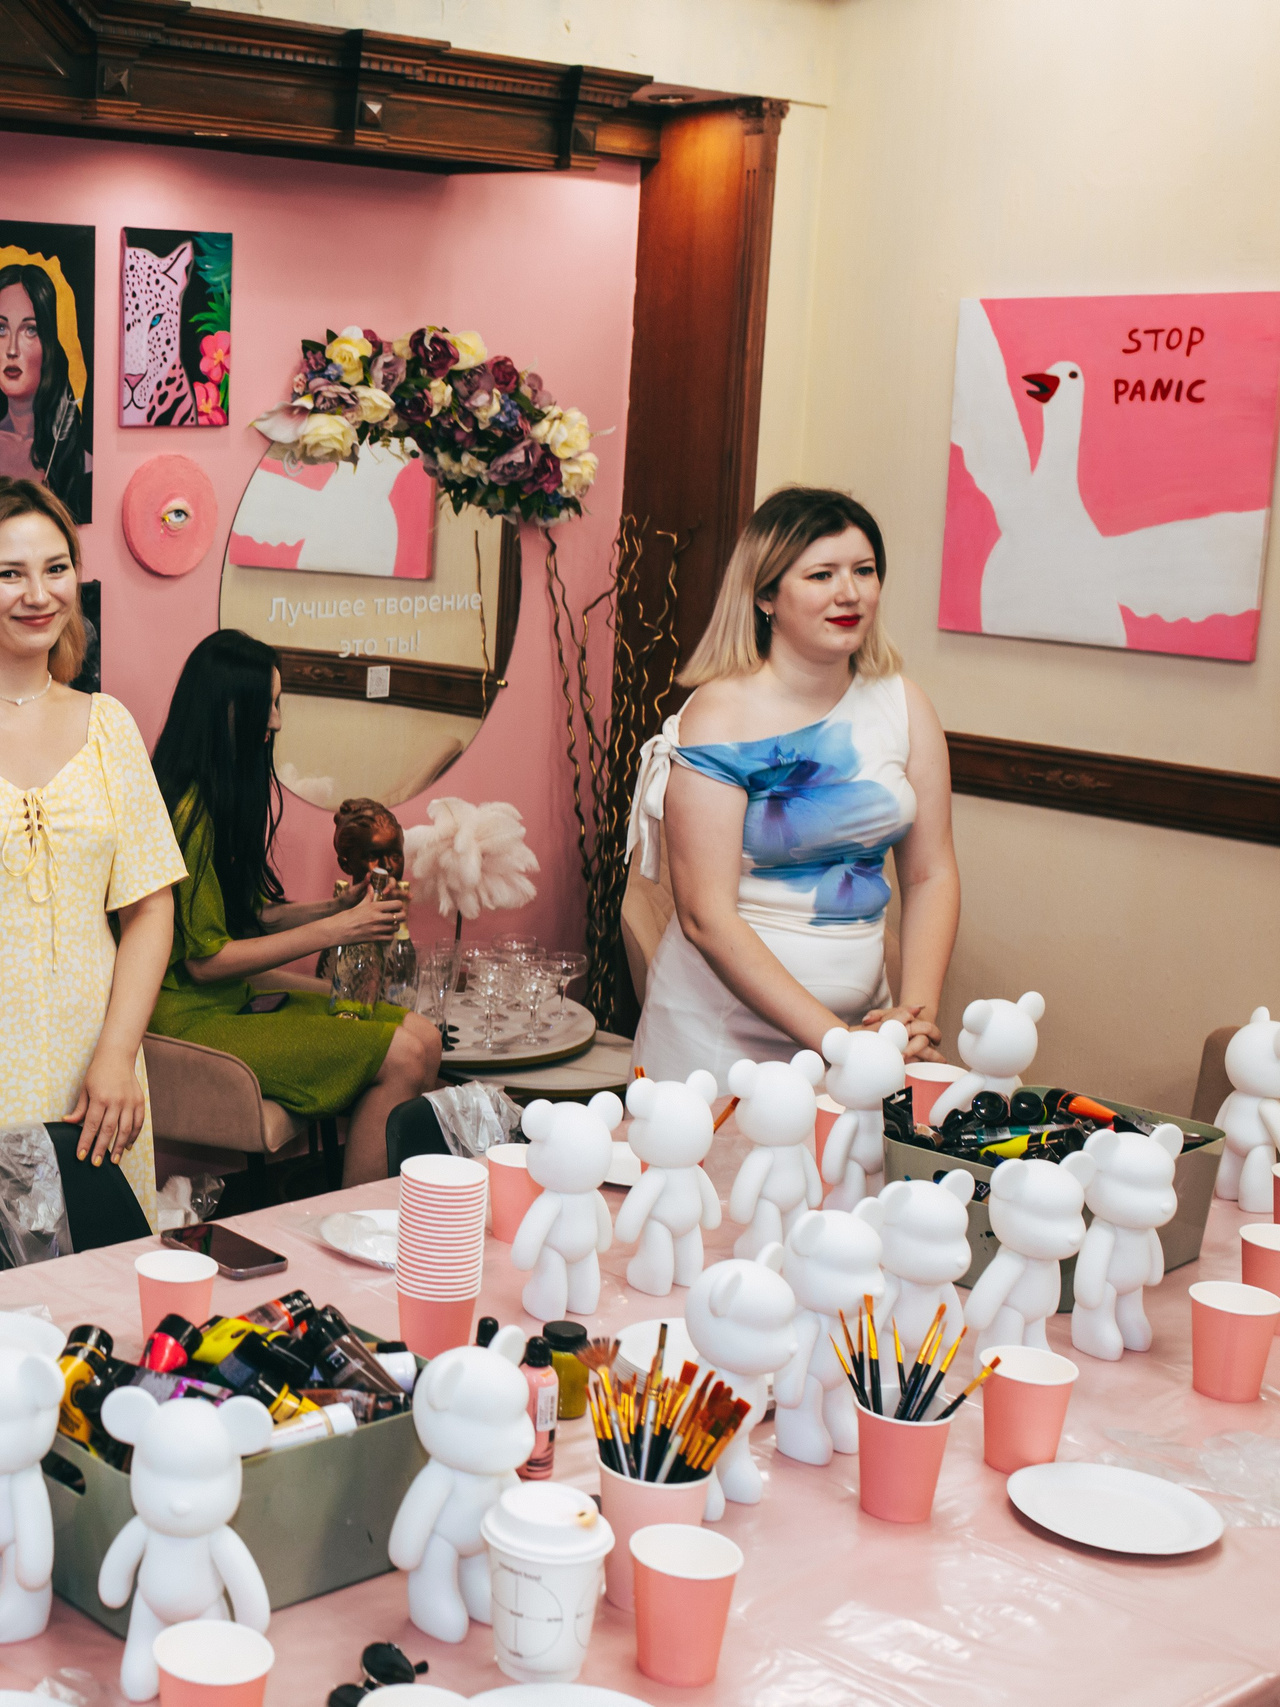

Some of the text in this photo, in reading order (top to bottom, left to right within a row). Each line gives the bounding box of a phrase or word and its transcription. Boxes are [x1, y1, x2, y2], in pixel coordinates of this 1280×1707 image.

[1122, 326, 1205, 357] STOP
[1114, 379, 1206, 404] PANIC
[268, 593, 481, 627] Лучшее творение
[338, 629, 420, 658] это ты!
